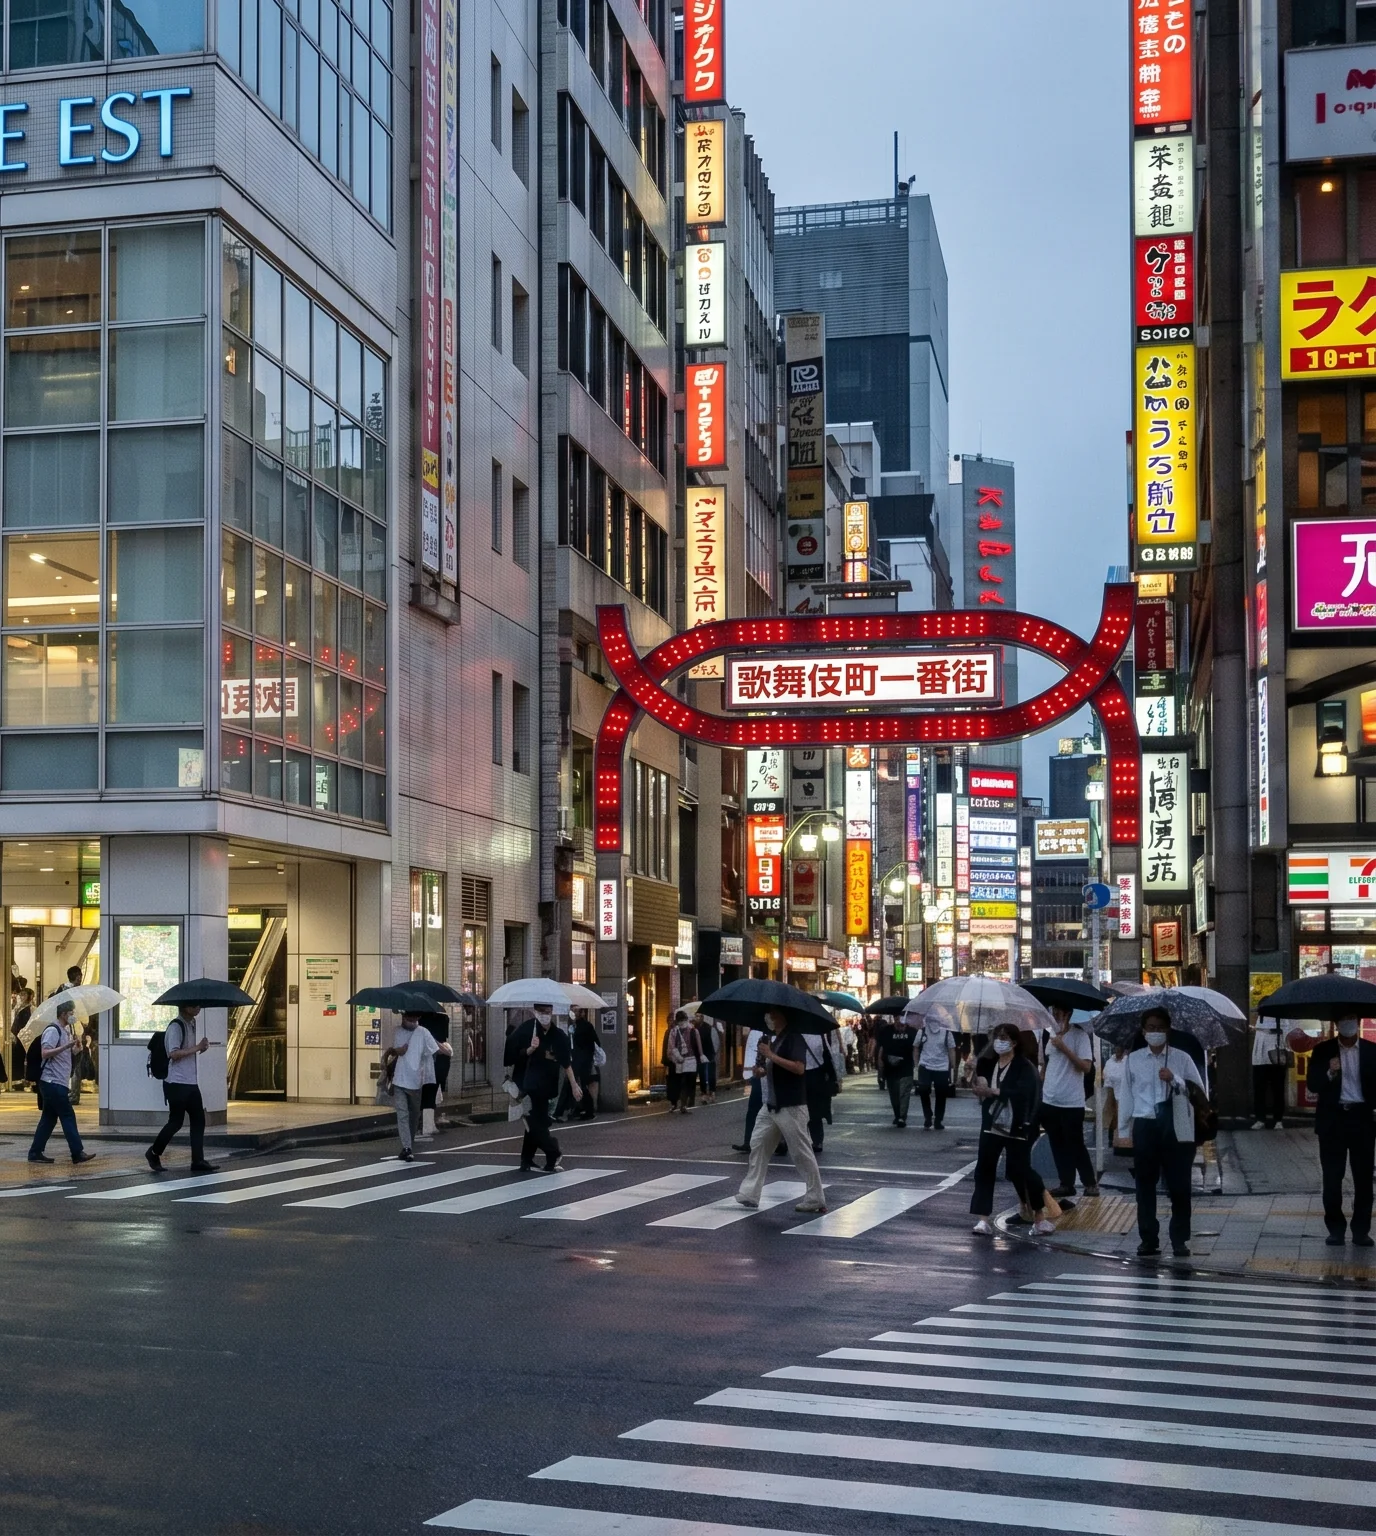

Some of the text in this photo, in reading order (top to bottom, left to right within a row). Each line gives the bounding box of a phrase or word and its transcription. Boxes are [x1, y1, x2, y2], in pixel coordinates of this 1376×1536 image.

[58, 86, 192, 168] EST
[737, 659, 988, 699] 歌舞伎町一番街
